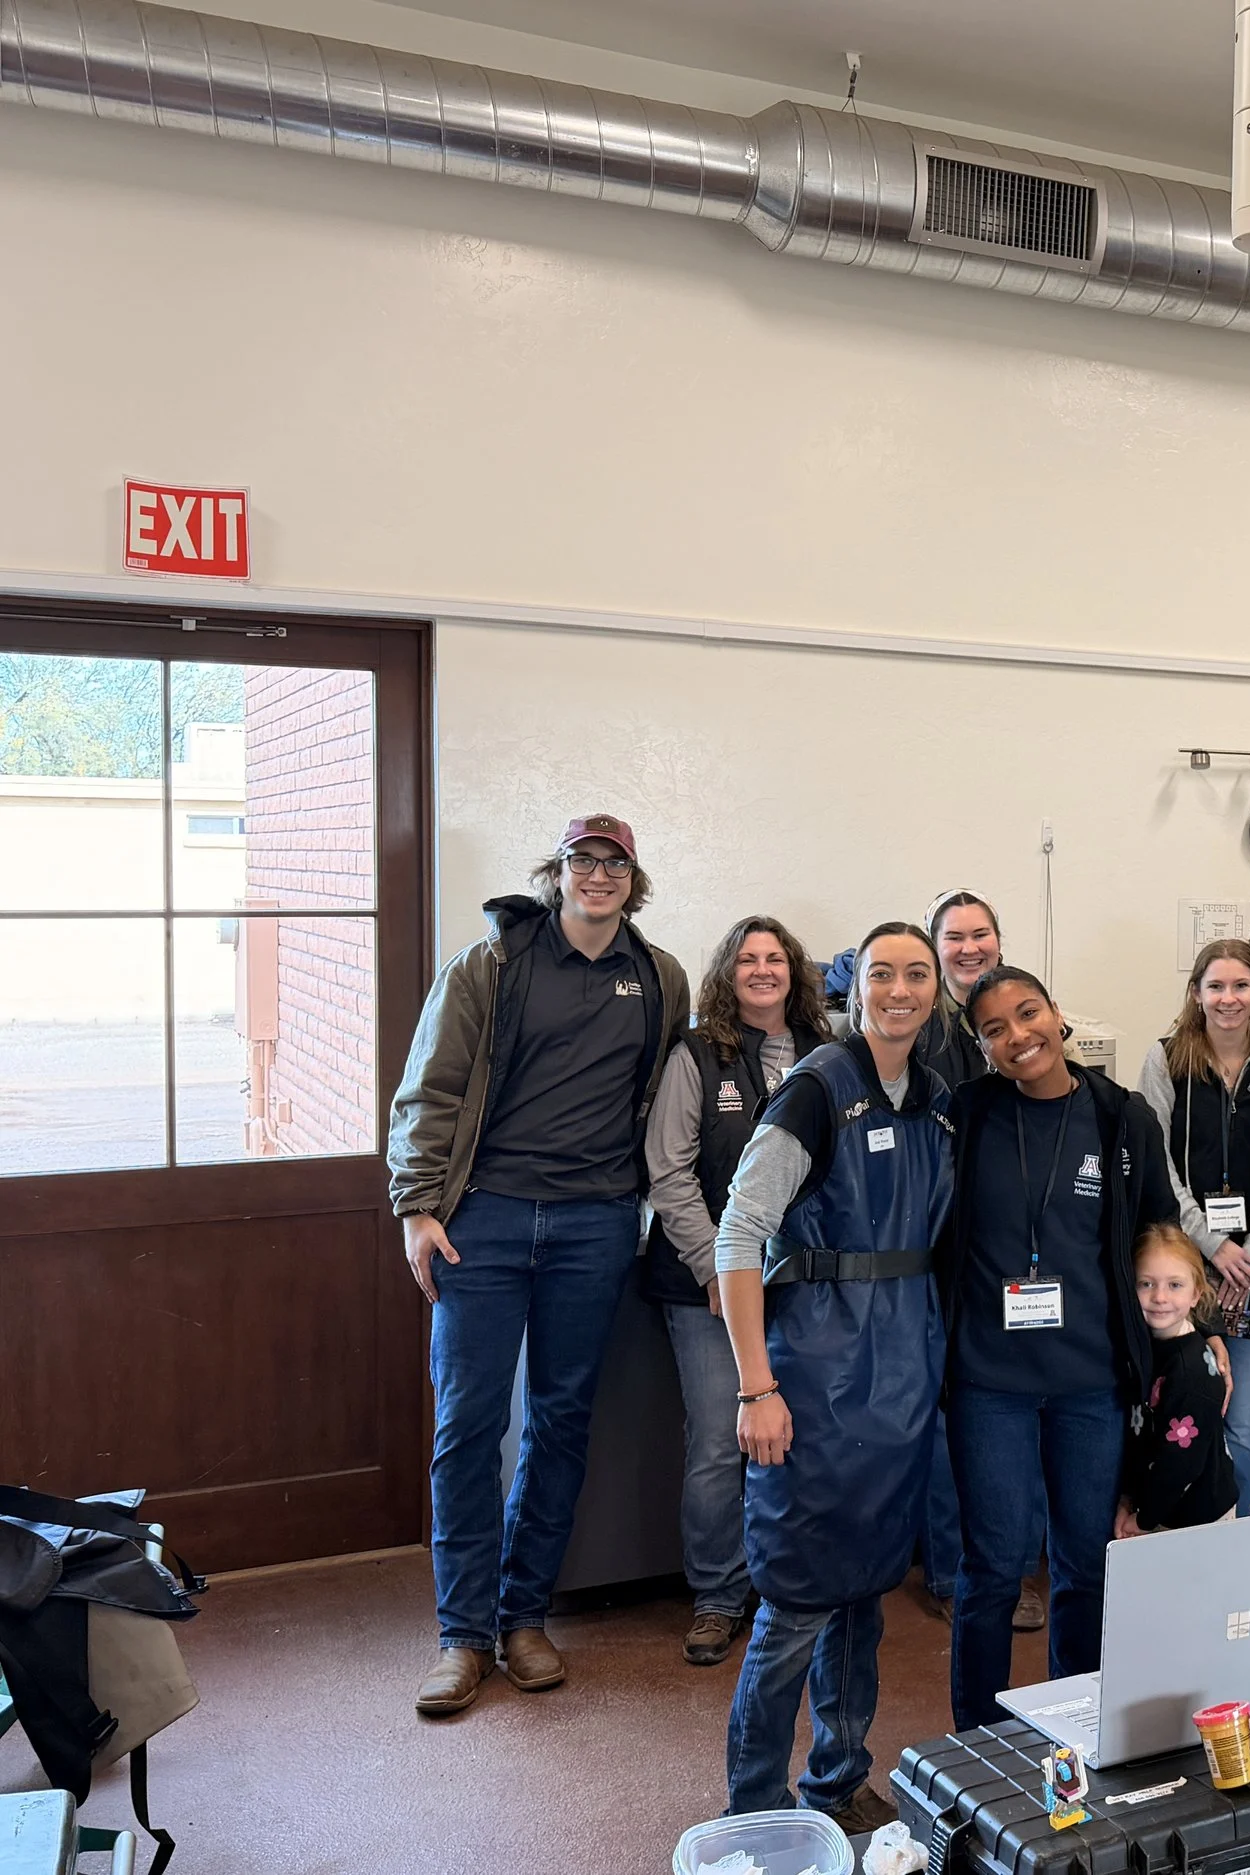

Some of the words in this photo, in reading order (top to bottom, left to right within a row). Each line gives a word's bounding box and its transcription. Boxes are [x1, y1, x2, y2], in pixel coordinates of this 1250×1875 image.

[129, 488, 243, 562] EXIT
[1078, 1154, 1102, 1178] A
[1073, 1180, 1102, 1192] Veterinary
[1073, 1188, 1100, 1198] Medicine
